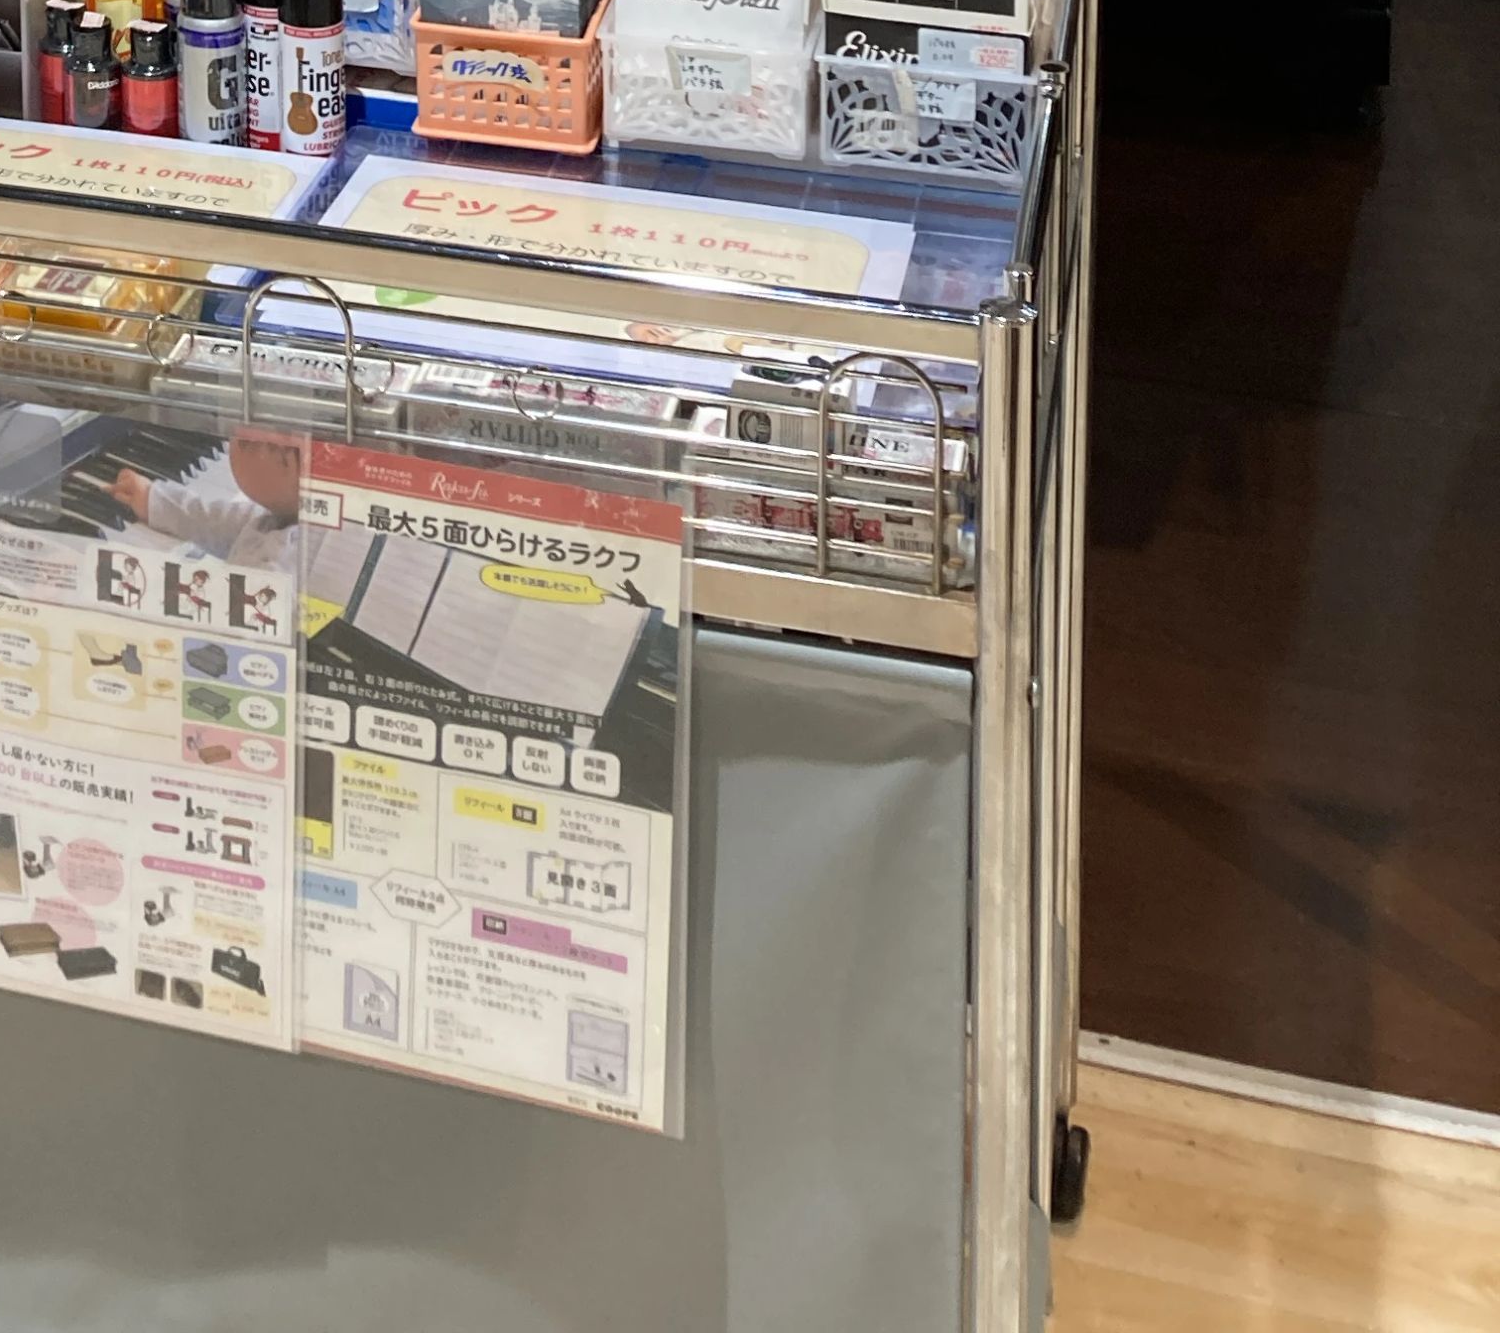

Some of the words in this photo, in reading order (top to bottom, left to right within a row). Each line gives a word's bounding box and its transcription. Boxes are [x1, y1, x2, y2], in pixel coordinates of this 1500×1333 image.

[402, 189, 560, 225] ピック
[366, 503, 642, 574] 最大5面ひらけるラクフ
